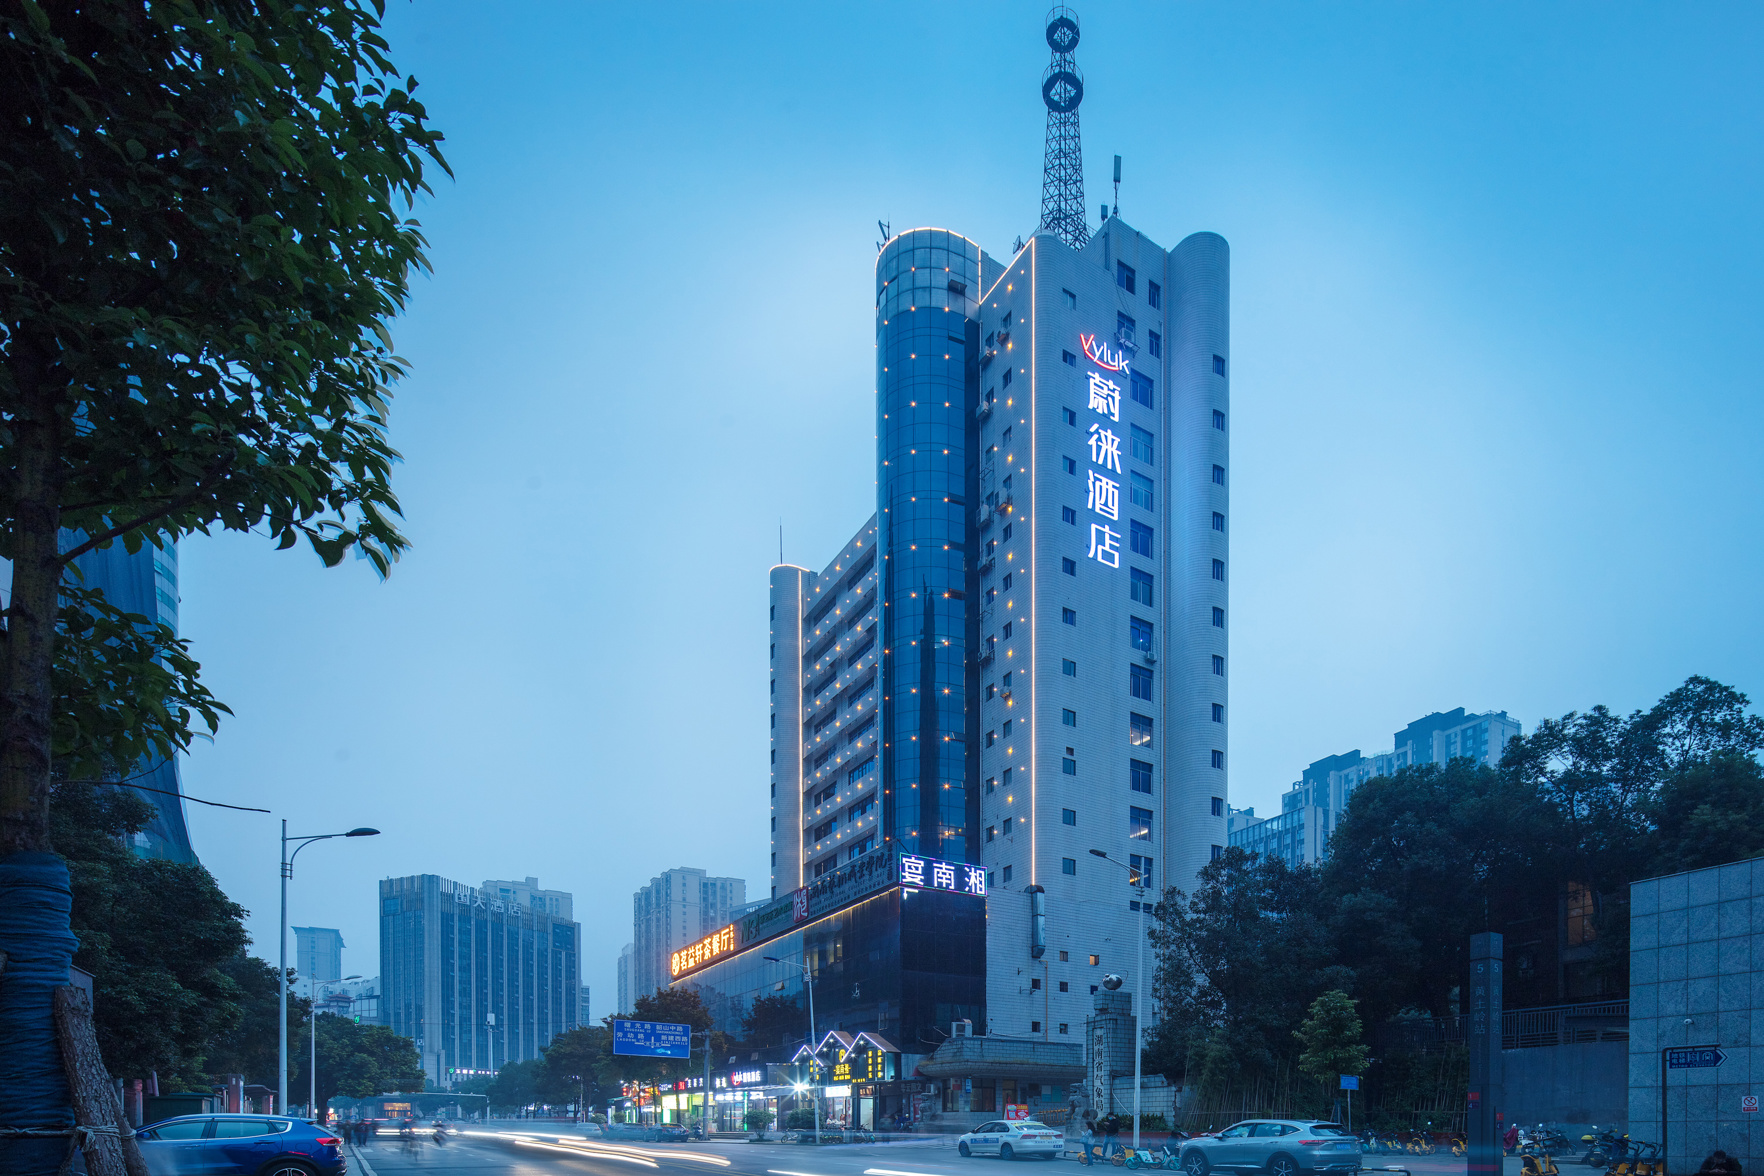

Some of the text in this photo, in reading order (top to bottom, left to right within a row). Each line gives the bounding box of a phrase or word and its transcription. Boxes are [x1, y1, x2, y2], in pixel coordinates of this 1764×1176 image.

[1088, 371, 1121, 569] 蔚徕酒店
[902, 856, 986, 895] 宴南湘
[680, 928, 730, 971] 茗益轩茶餐厅
[1477, 964, 1484, 973] 5
[1494, 963, 1499, 973] 5
[1474, 986, 1486, 1034] 黄土岭站
[1094, 1034, 1104, 1112] 湖南省气象局
